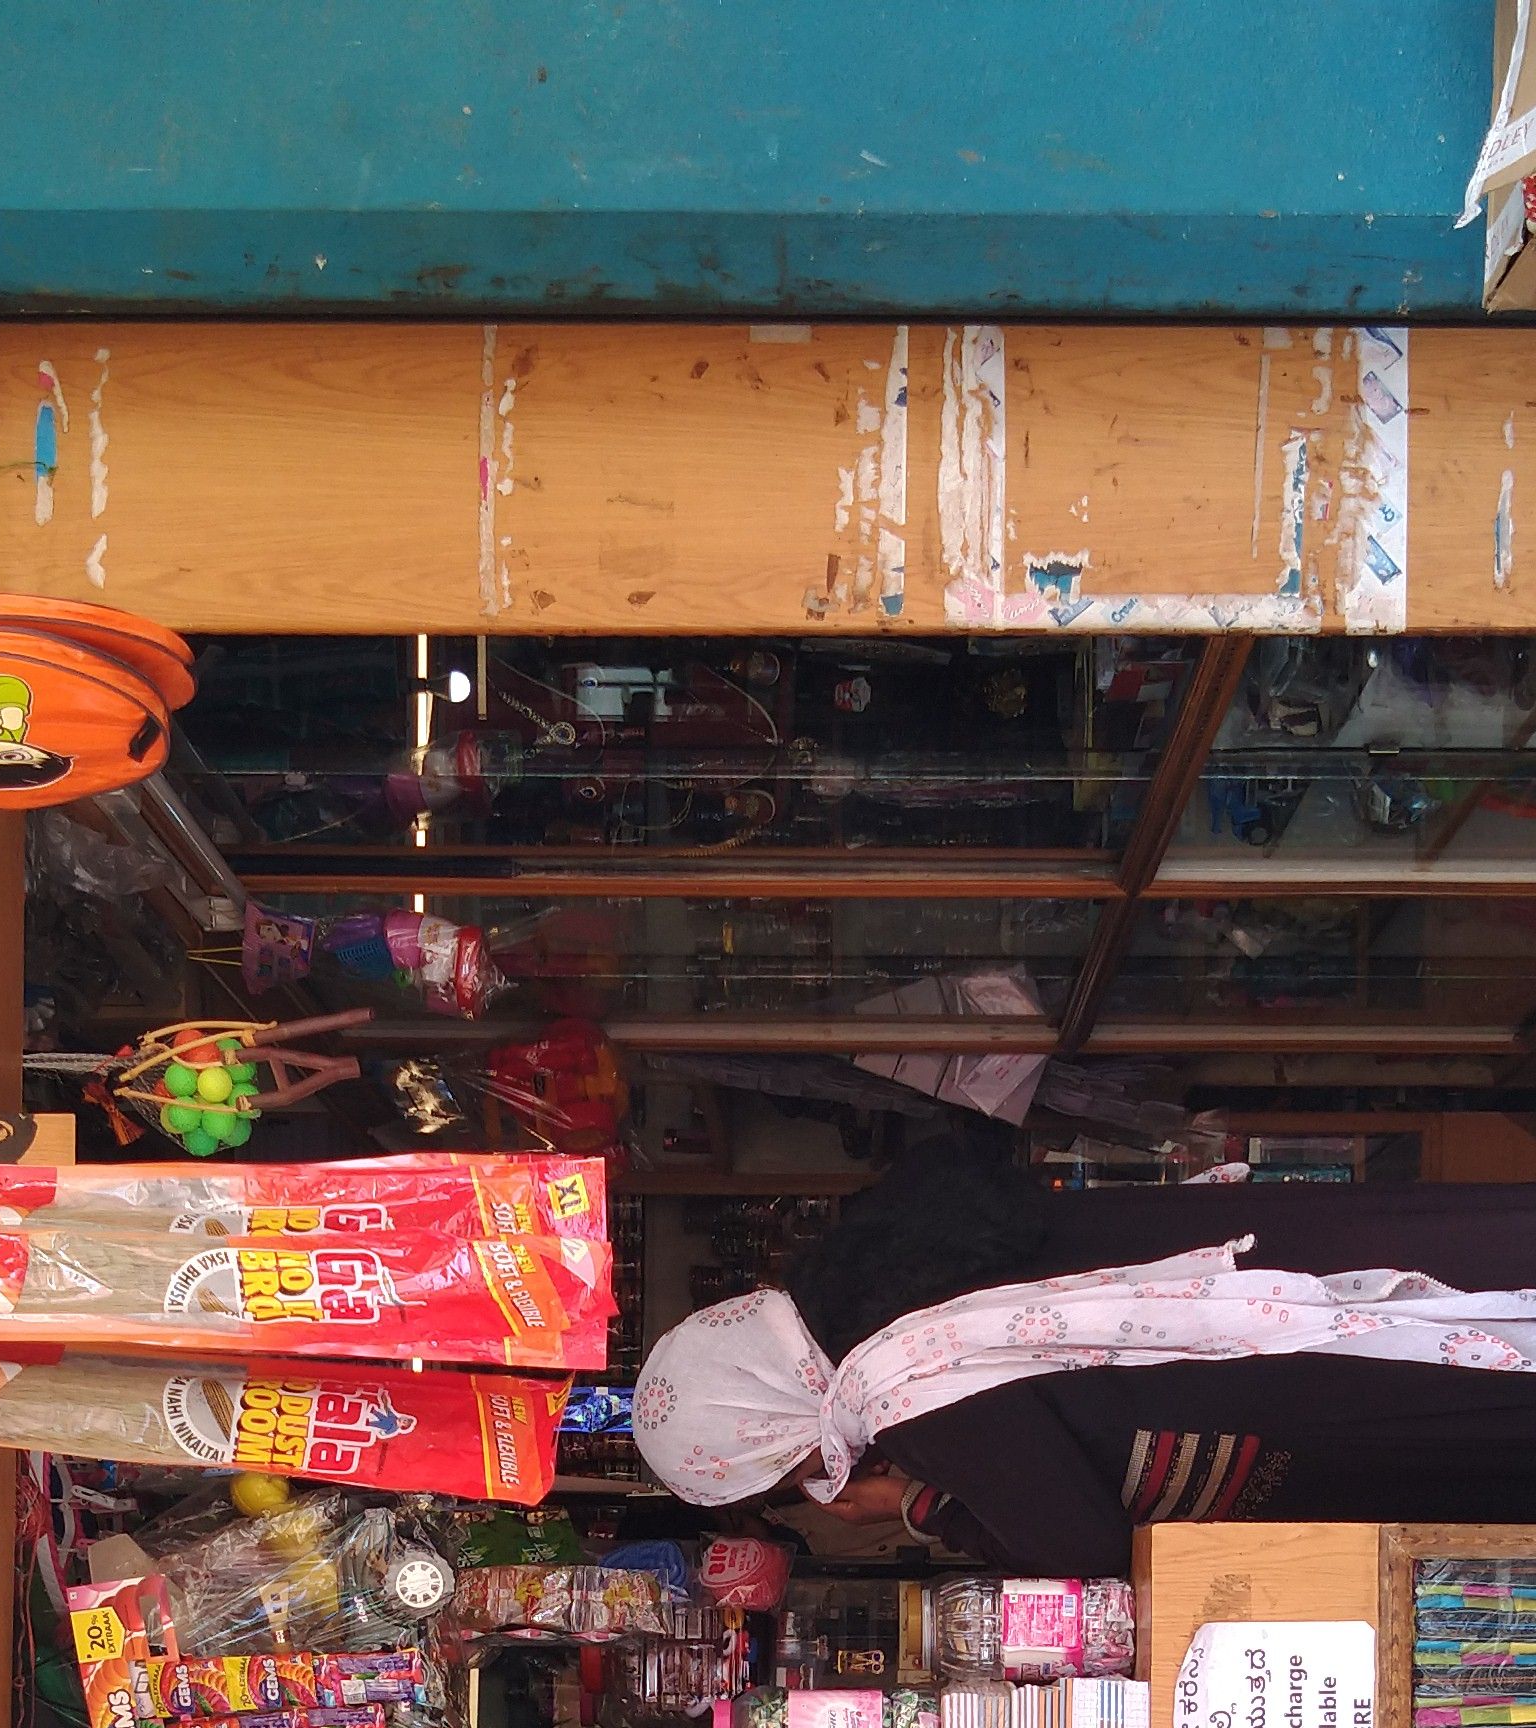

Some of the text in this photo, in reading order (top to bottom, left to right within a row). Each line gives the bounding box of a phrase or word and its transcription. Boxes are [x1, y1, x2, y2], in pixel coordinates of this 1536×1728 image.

[555, 1182, 580, 1216] XL
[196, 1252, 230, 1268] ISKA
[278, 1251, 310, 1292] NO
[238, 1250, 281, 1320] BRO
[166, 1388, 185, 1421] NAHI
[510, 1396, 527, 1425] NEW
[277, 1394, 310, 1468] DUST
[496, 1431, 522, 1487] FLEXIBLE
[707, 1542, 729, 1576] BIG
[174, 1663, 193, 1708] GEMS
[261, 1657, 280, 1702] GEMS
